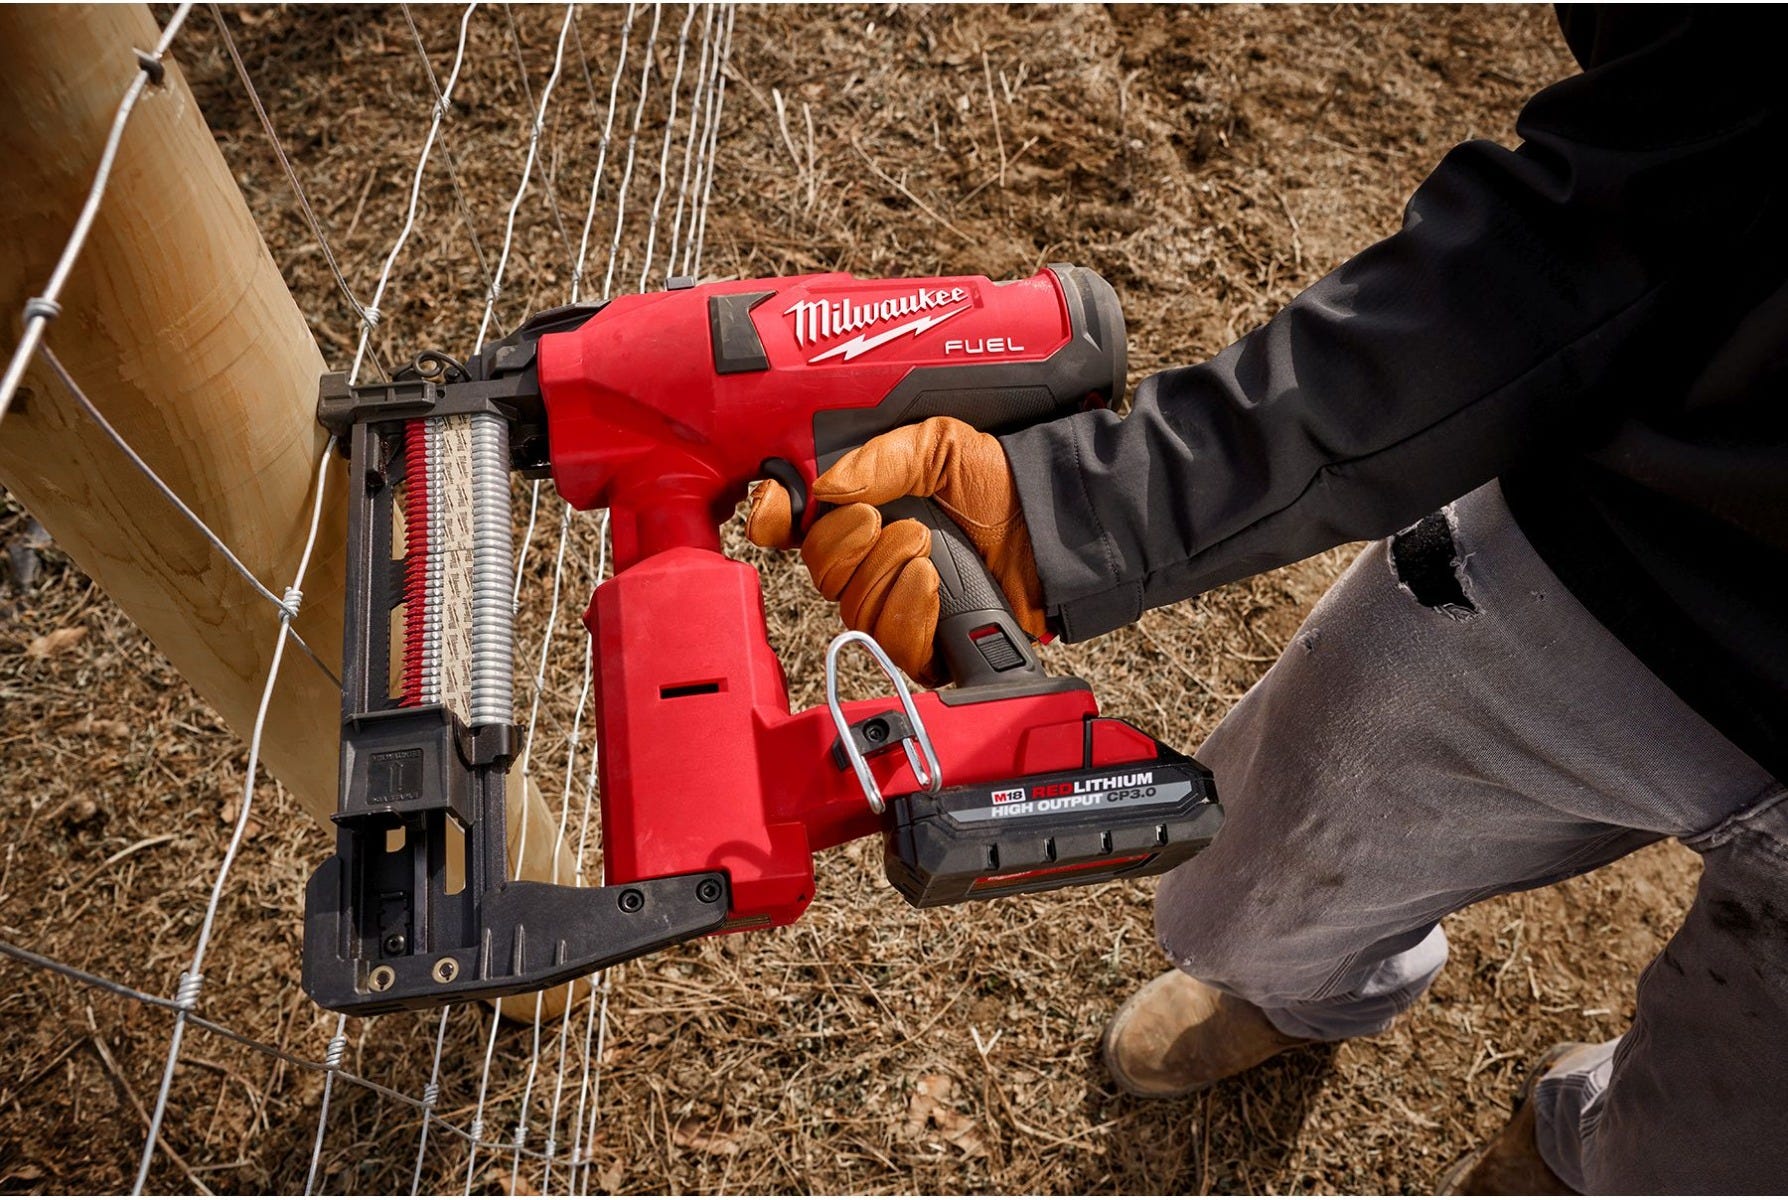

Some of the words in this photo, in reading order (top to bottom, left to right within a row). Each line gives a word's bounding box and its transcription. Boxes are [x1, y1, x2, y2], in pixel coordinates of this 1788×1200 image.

[783, 286, 969, 349] Milwaukee
[945, 337, 1025, 354] FUEL
[991, 802, 1033, 817] HIGH
[1037, 794, 1103, 812] OUTPUT
[1107, 787, 1157, 802] CP3.0
[994, 790, 1023, 803] M18
